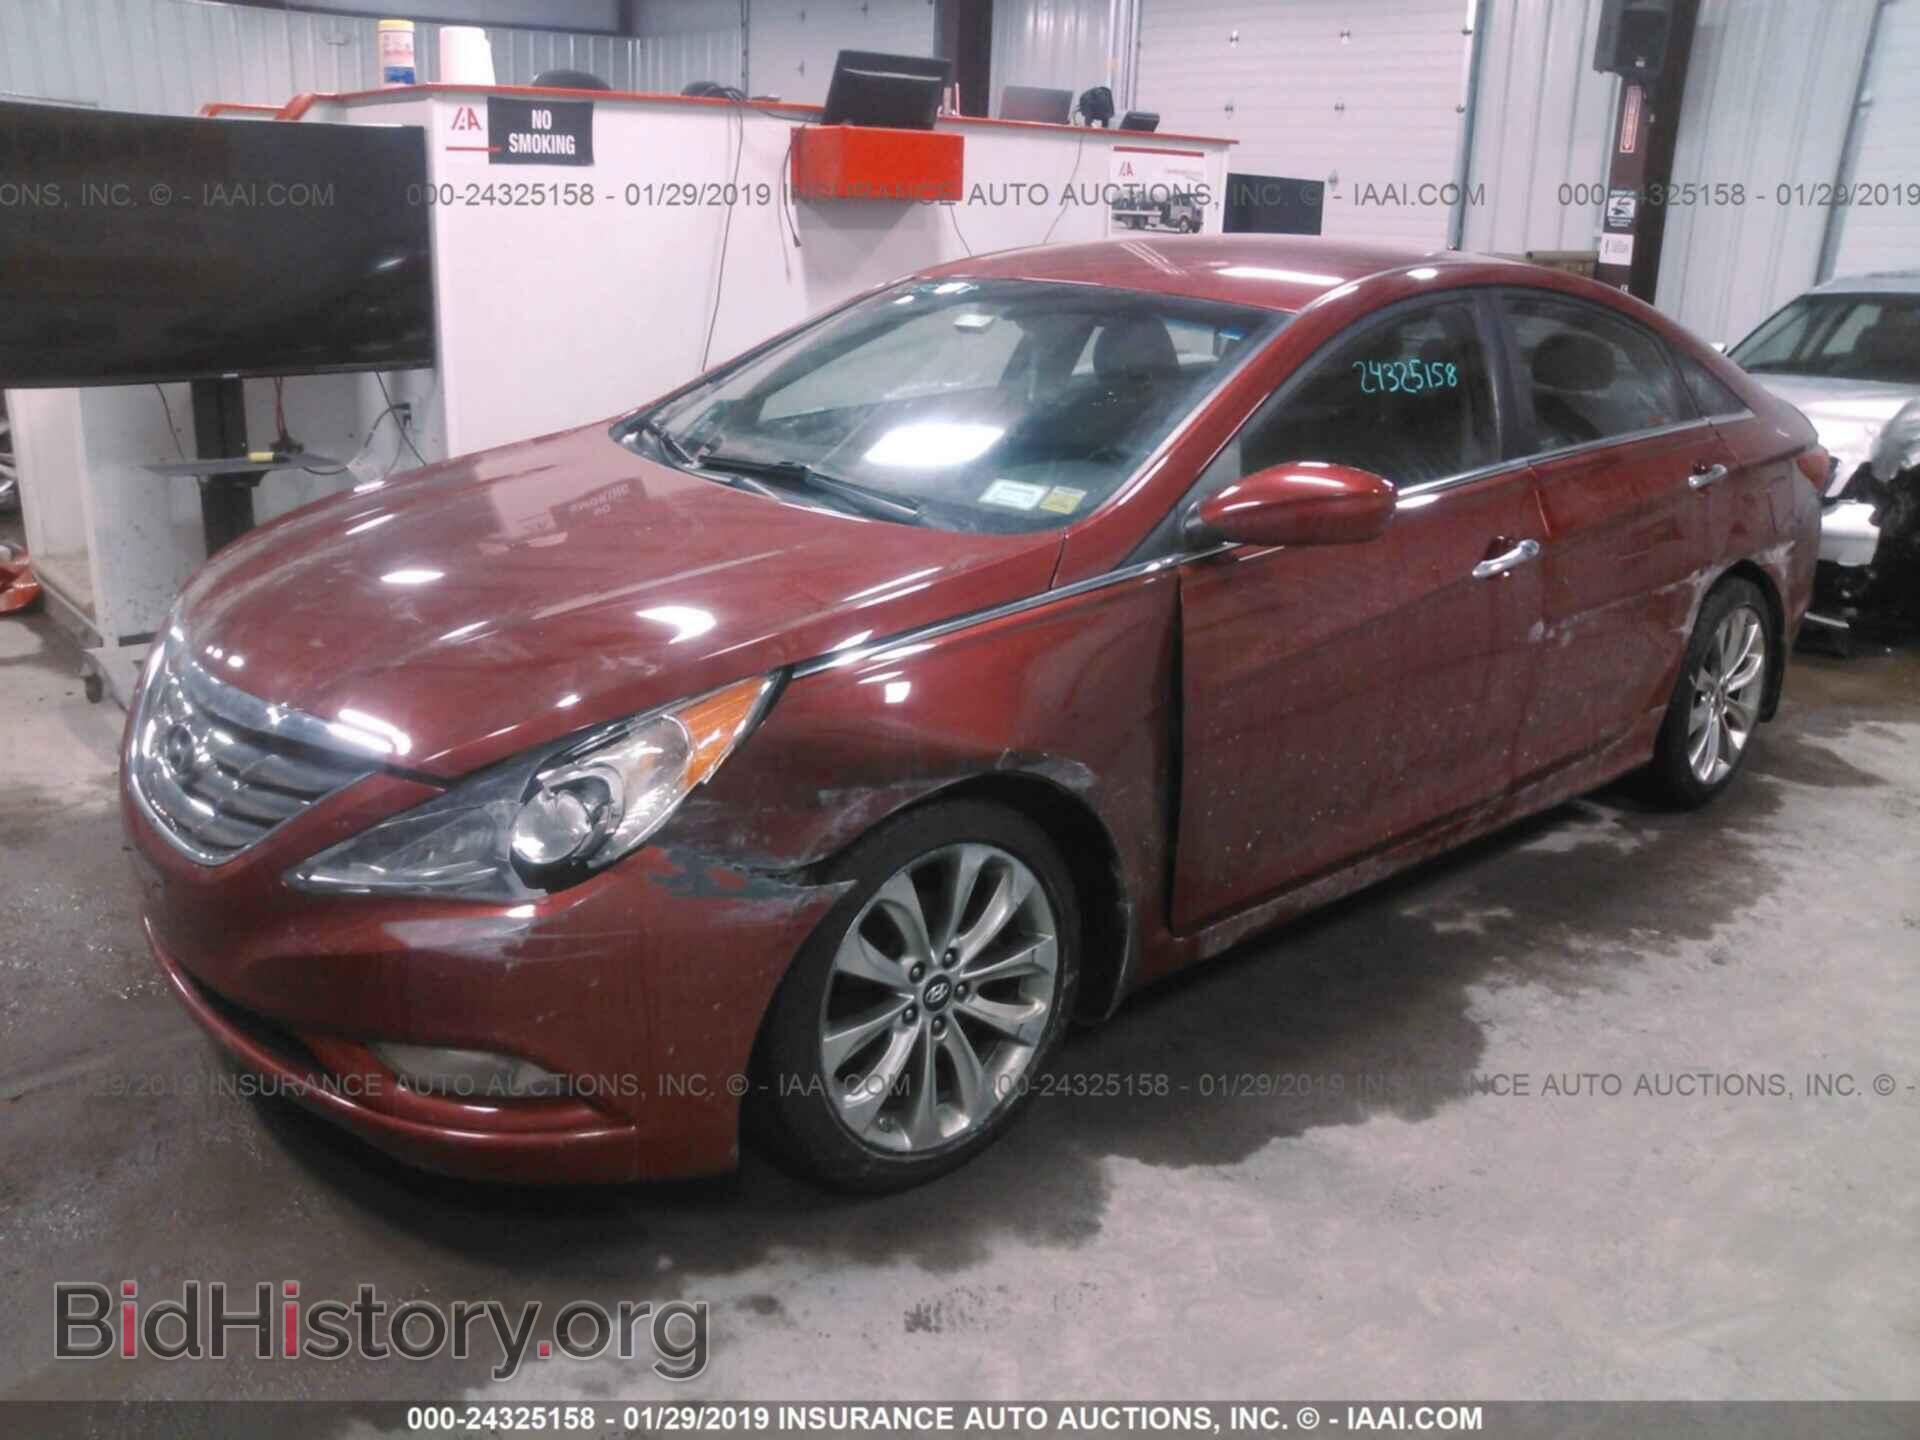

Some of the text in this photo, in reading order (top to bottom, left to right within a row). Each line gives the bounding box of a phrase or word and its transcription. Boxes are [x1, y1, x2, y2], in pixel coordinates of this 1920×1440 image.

[531, 109, 552, 130] NO
[508, 132, 576, 155] SMOKING
[1352, 359, 1458, 393] 24325158
